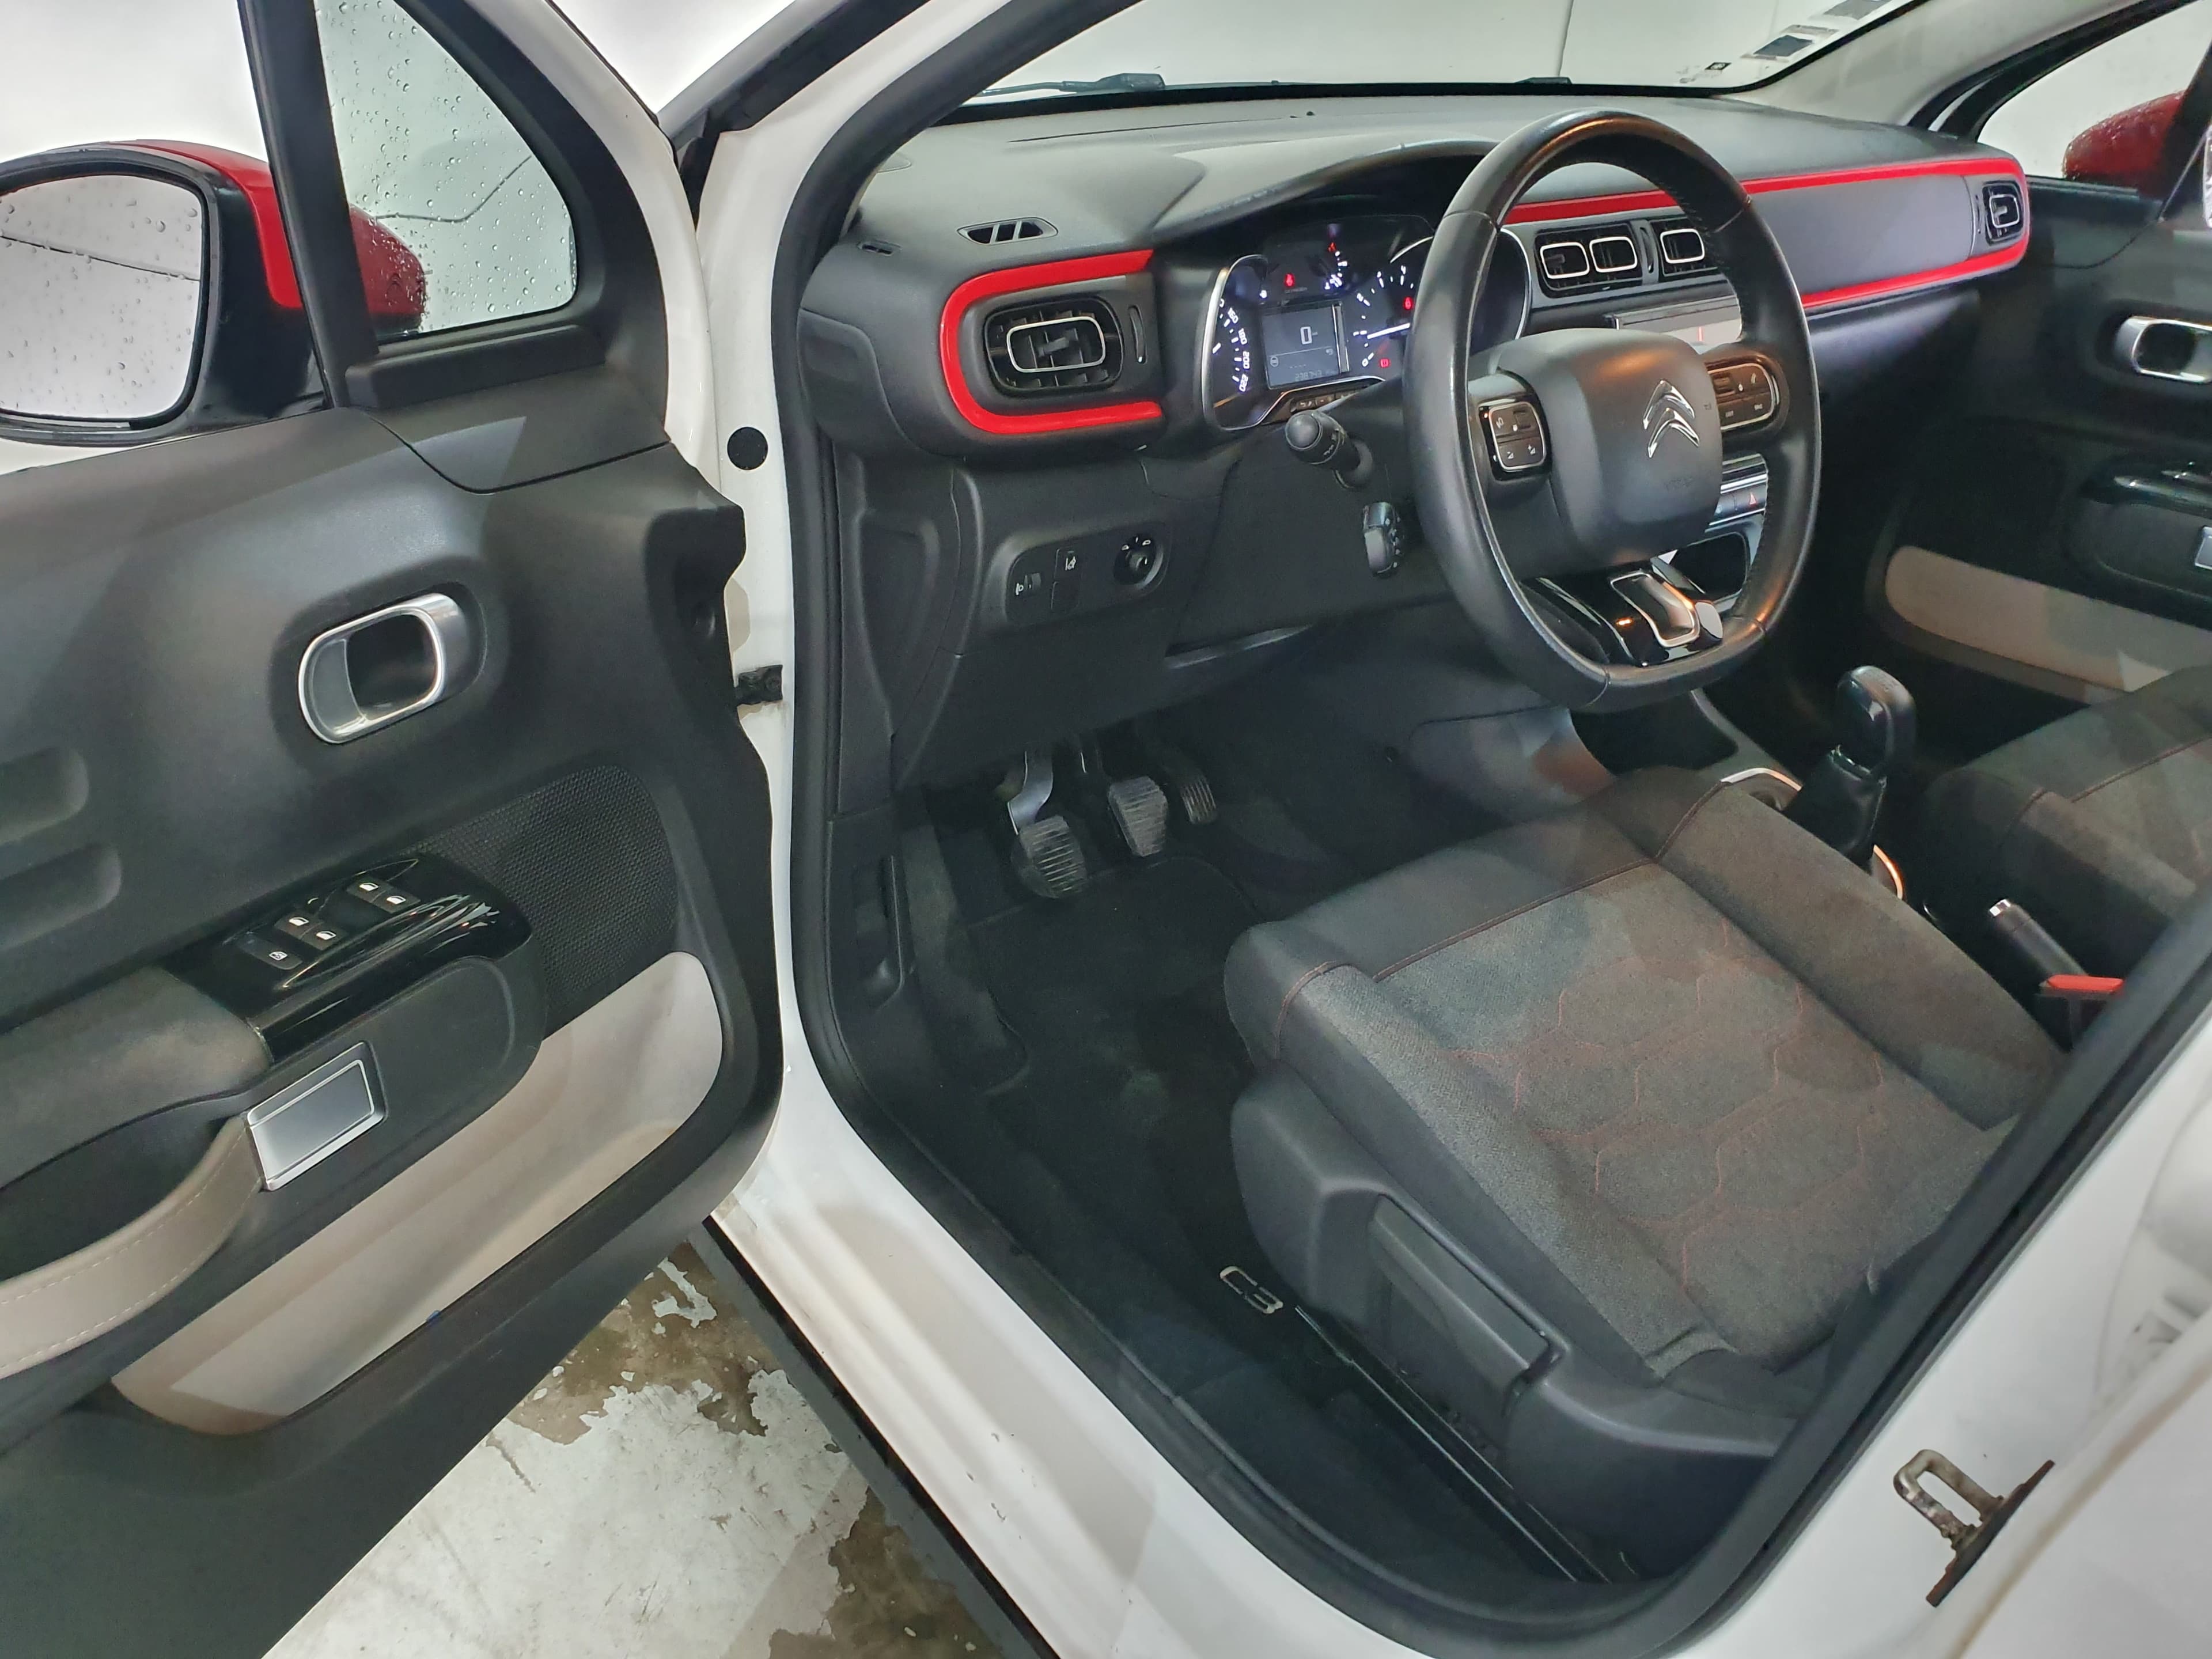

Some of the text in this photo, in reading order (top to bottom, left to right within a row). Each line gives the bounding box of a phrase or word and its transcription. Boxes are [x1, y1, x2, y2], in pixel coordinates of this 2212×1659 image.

[1227, 307, 1239, 324] 160
[1238, 327, 1248, 345] 180
[1300, 326, 1313, 345] 0
[1361, 358, 1369, 368] 0
[1238, 373, 1249, 392] 220
[1219, 1266, 1283, 1314] C3
